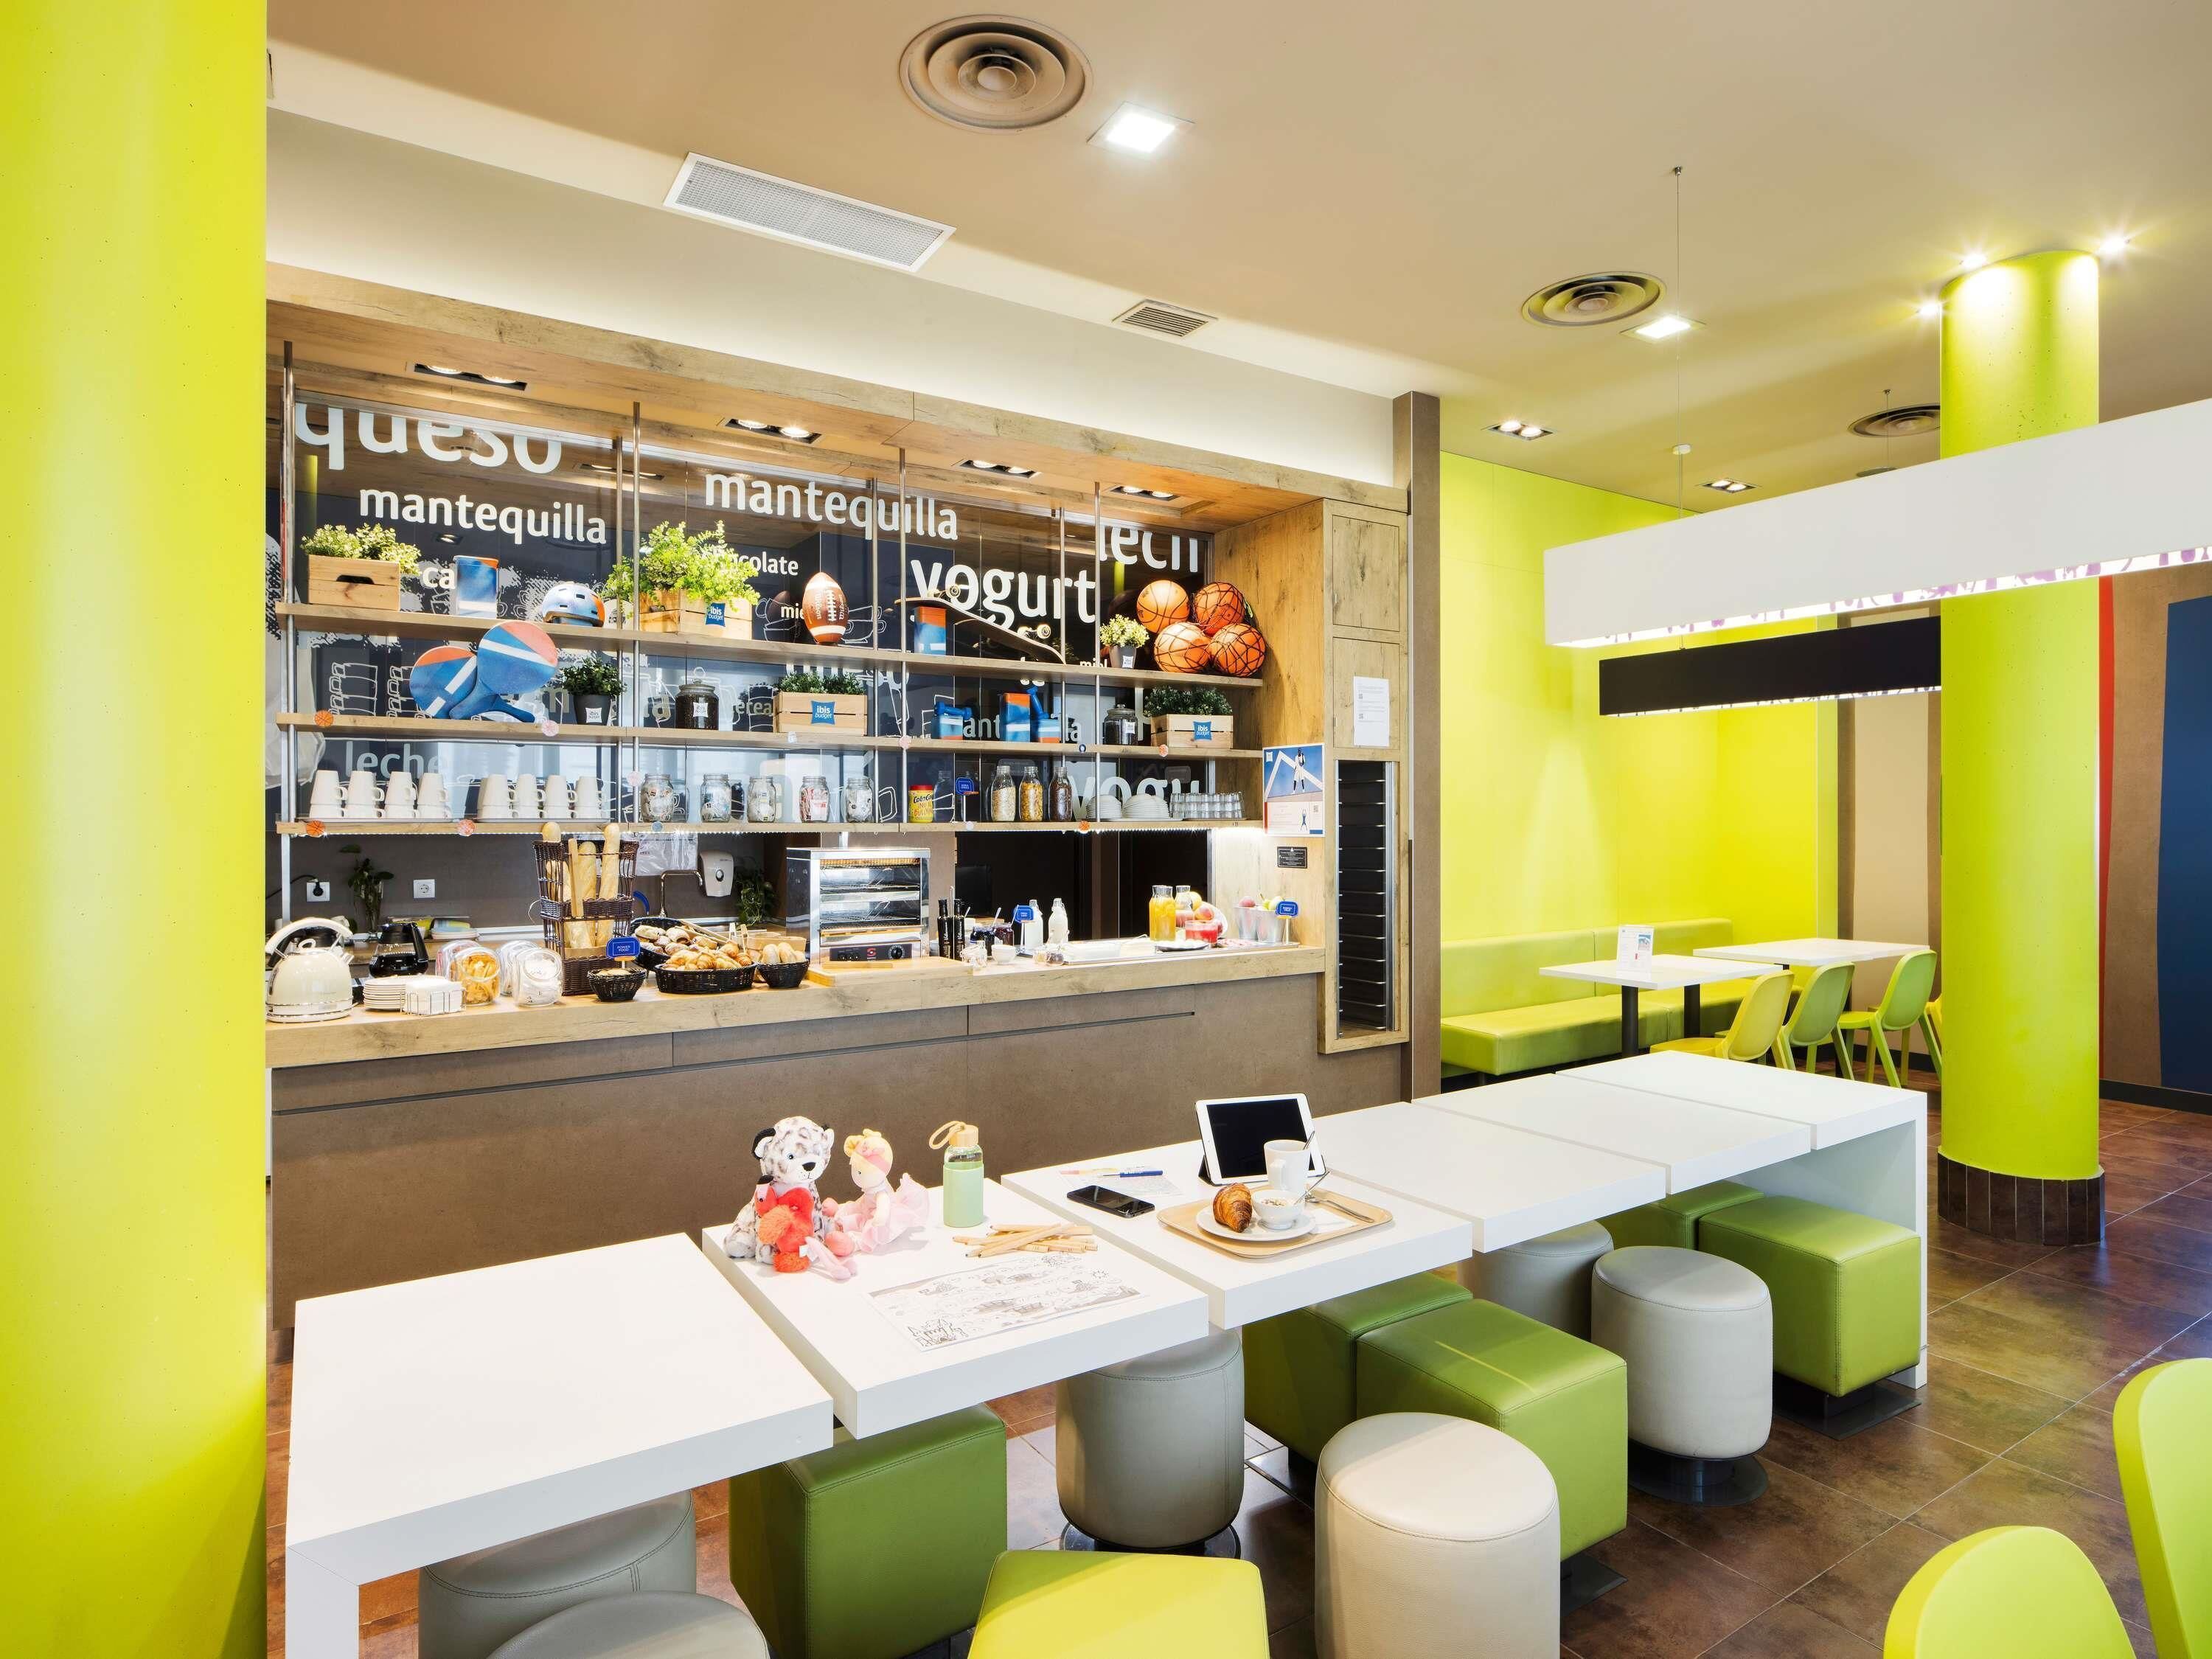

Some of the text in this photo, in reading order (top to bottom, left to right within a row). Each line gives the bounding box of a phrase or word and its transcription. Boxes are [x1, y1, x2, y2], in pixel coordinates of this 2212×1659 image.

[296, 403, 562, 474] queso
[360, 490, 606, 545] mantequilla
[706, 473, 958, 540] mantequilla
[422, 566, 456, 590] ca
[710, 606, 723, 616] ibis
[780, 603, 805, 620] mi
[816, 705, 830, 714] ibis
